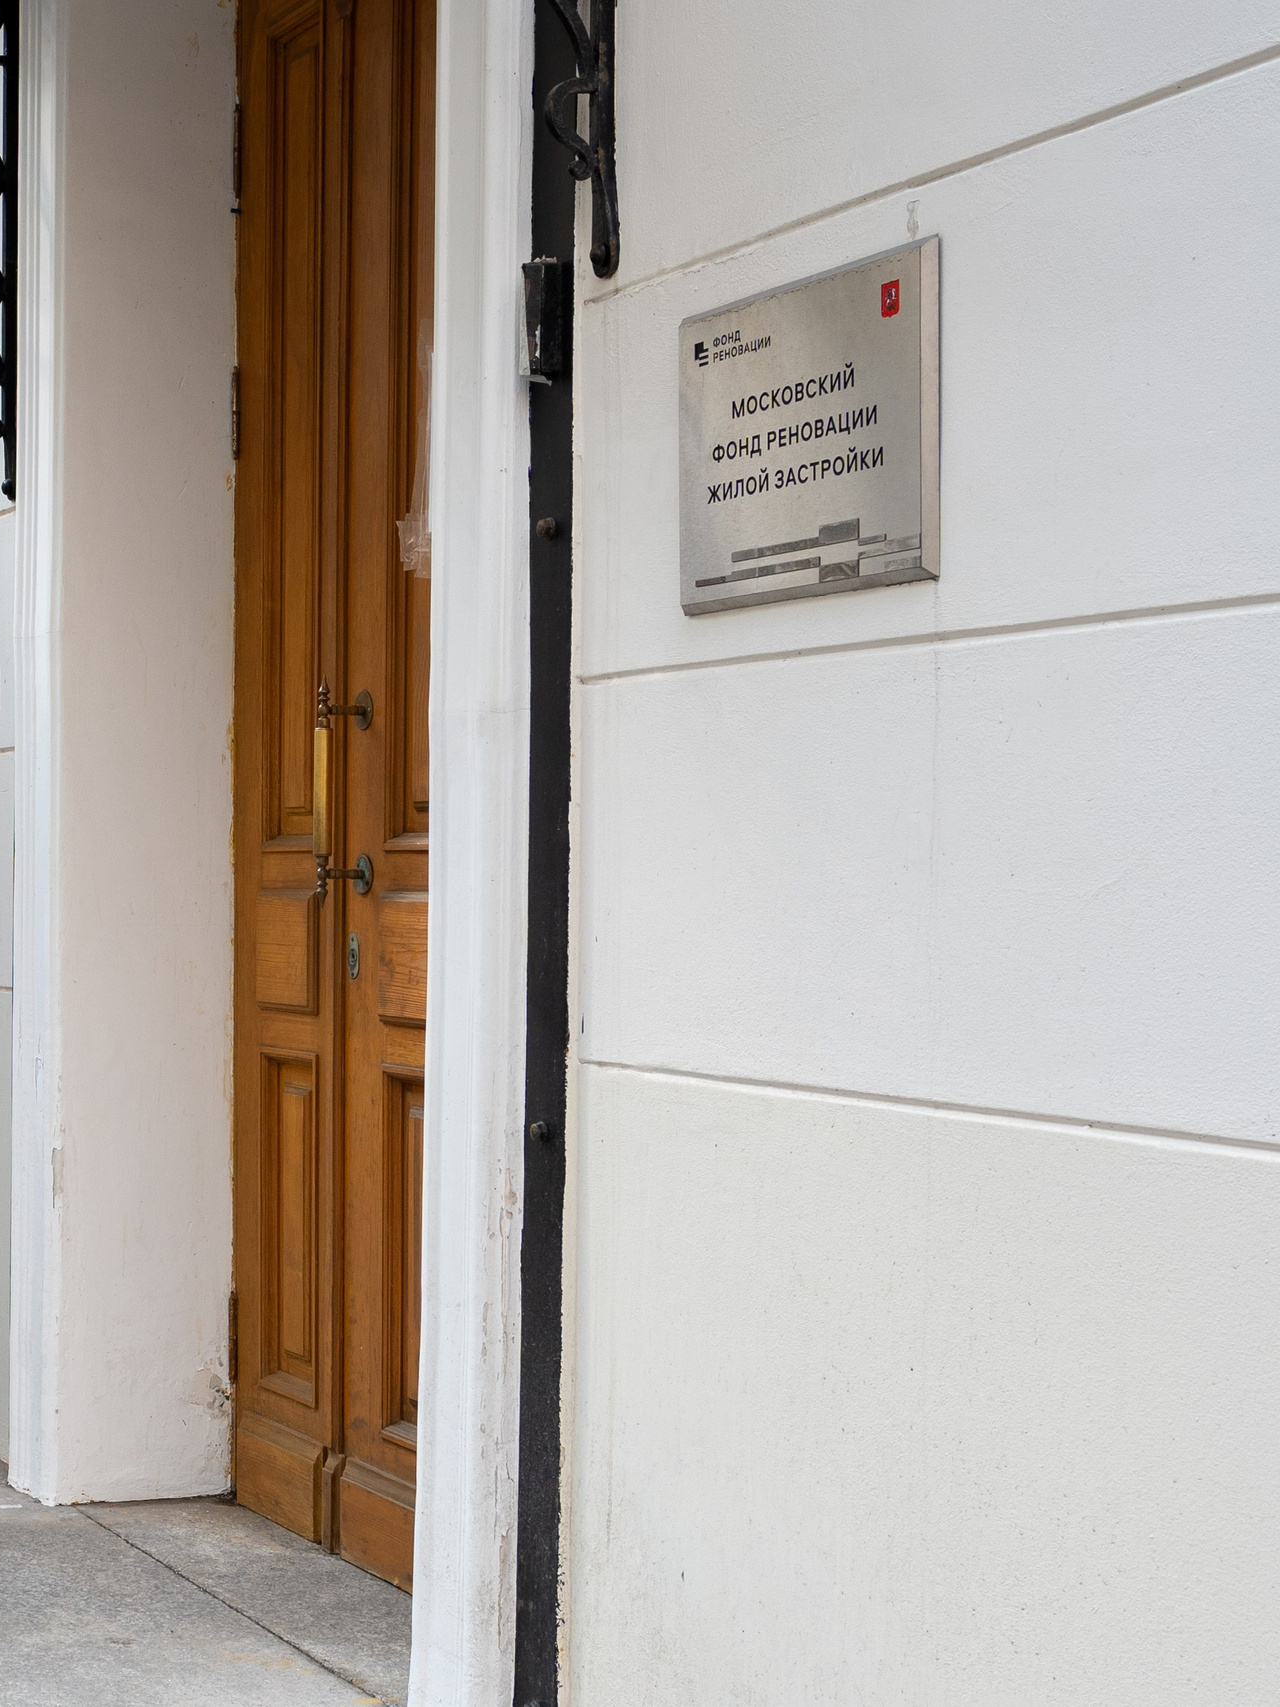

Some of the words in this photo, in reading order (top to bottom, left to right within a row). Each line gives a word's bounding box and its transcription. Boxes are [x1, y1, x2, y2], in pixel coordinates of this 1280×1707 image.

[712, 330, 741, 348] ФОНД
[712, 335, 771, 363] РЕНОВАЦИИ
[731, 361, 855, 419] МОСКОВСКИЙ
[712, 434, 762, 463] ФОНД
[767, 404, 878, 450] РЕНОВАЦИИ
[707, 467, 770, 504] ЖИЛОЙ
[774, 446, 884, 489] ЗАСТРОЙКИ
